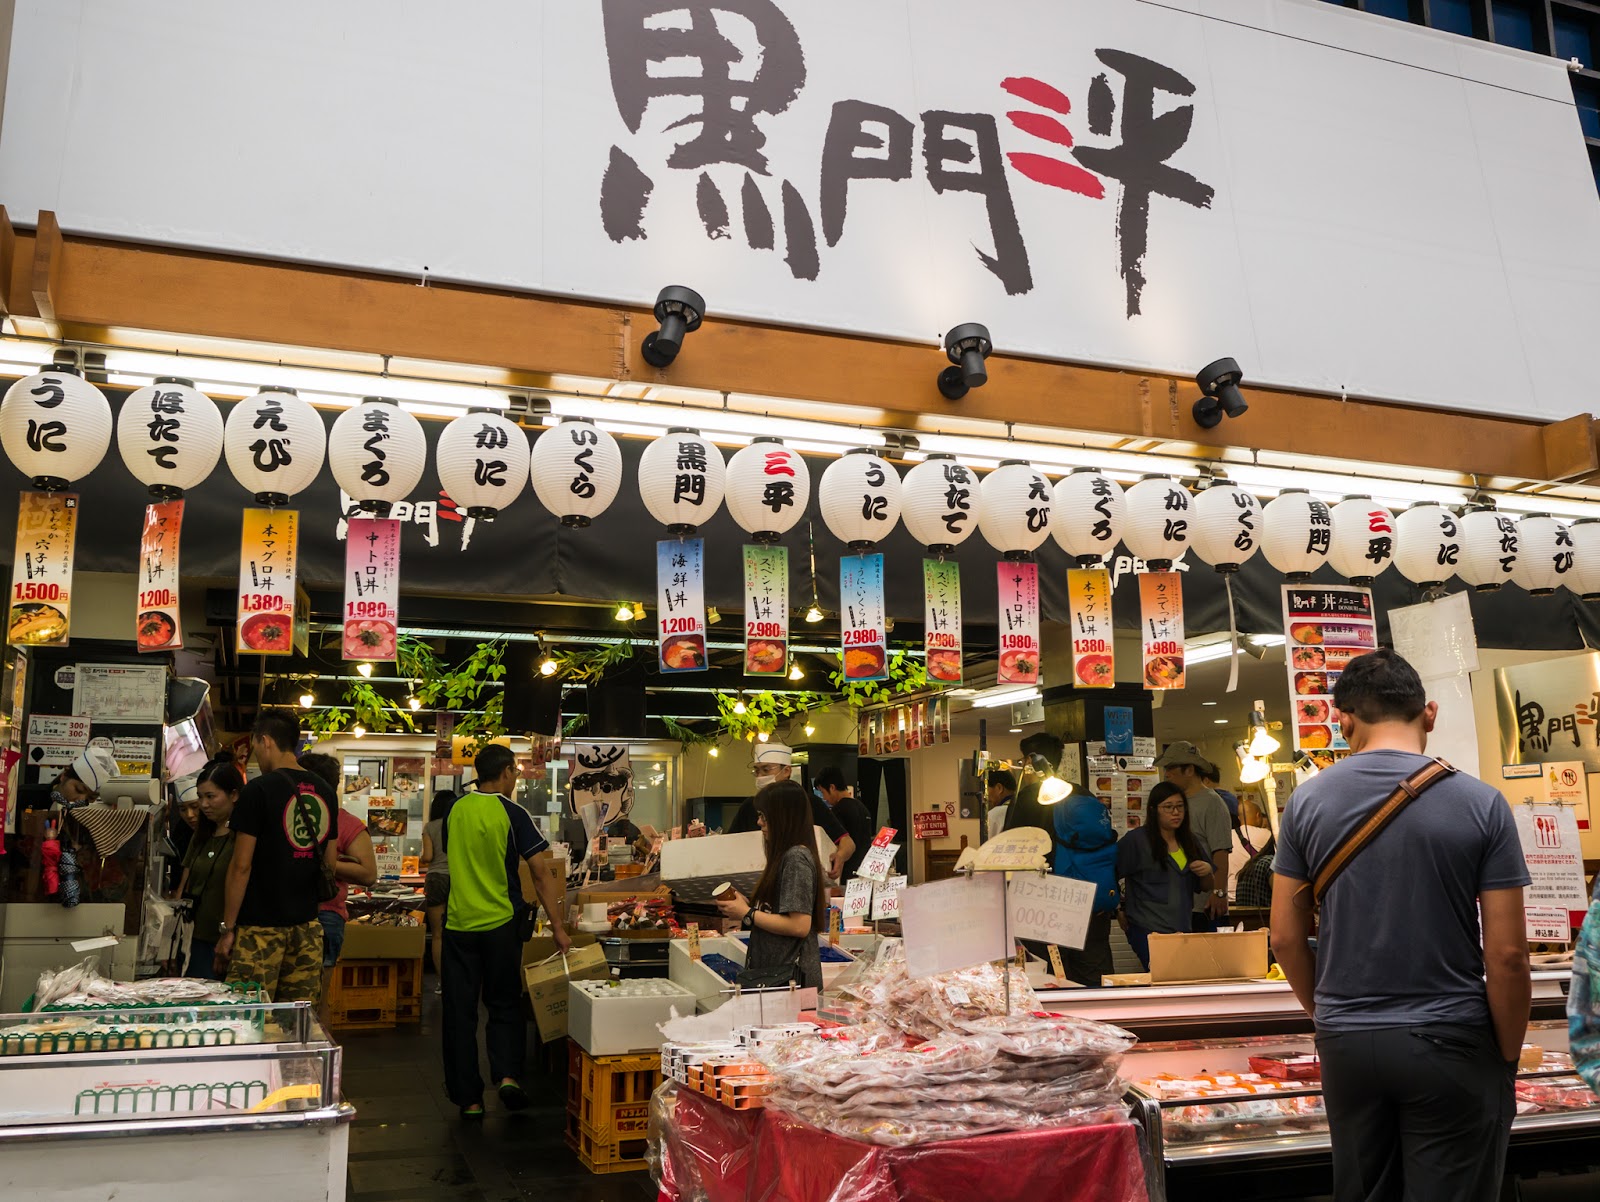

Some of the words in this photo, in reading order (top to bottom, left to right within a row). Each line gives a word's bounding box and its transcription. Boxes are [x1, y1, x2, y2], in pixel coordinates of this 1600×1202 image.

[600, 0, 1216, 321] 黒門三平
[26, 378, 67, 453] うに
[147, 389, 185, 469] ほたて
[249, 400, 292, 473] えび
[360, 409, 391, 487] まぐろ
[474, 423, 508, 487] かに
[570, 429, 598, 499] いくら
[674, 441, 707, 506] 黒門
[761, 451, 795, 513] 三平
[862, 462, 888, 521] うに
[941, 464, 971, 534] ほたて
[1026, 475, 1051, 533] えび
[1090, 476, 1115, 541] まぐろ
[1163, 488, 1189, 542] かに
[1231, 492, 1254, 552] いくら
[1306, 501, 1331, 555] 黒門
[1365, 510, 1392, 564] 三平
[1437, 514, 1459, 565] うに
[1494, 516, 1518, 573] ほたて
[33, 539, 51, 578] 穴子丼
[260, 523, 278, 591] 本マグロ丼
[363, 531, 379, 594] 中トロ丼
[1554, 525, 1574, 574] えび
[672, 553, 688, 608] 海鮮丼
[760, 558, 773, 618] スペシャル丼
[857, 567, 867, 629] うにいくら丼
[937, 571, 948, 630] スペシャル丼
[1013, 574, 1025, 628] 中トロ丼
[1083, 581, 1097, 636] 本マグロ丼
[1322, 593, 1337, 610] 丼
[1338, 597, 1359, 605] メニュー
[851, 896, 866, 910] 680
[1535, 929, 1559, 937] 持込禁止
